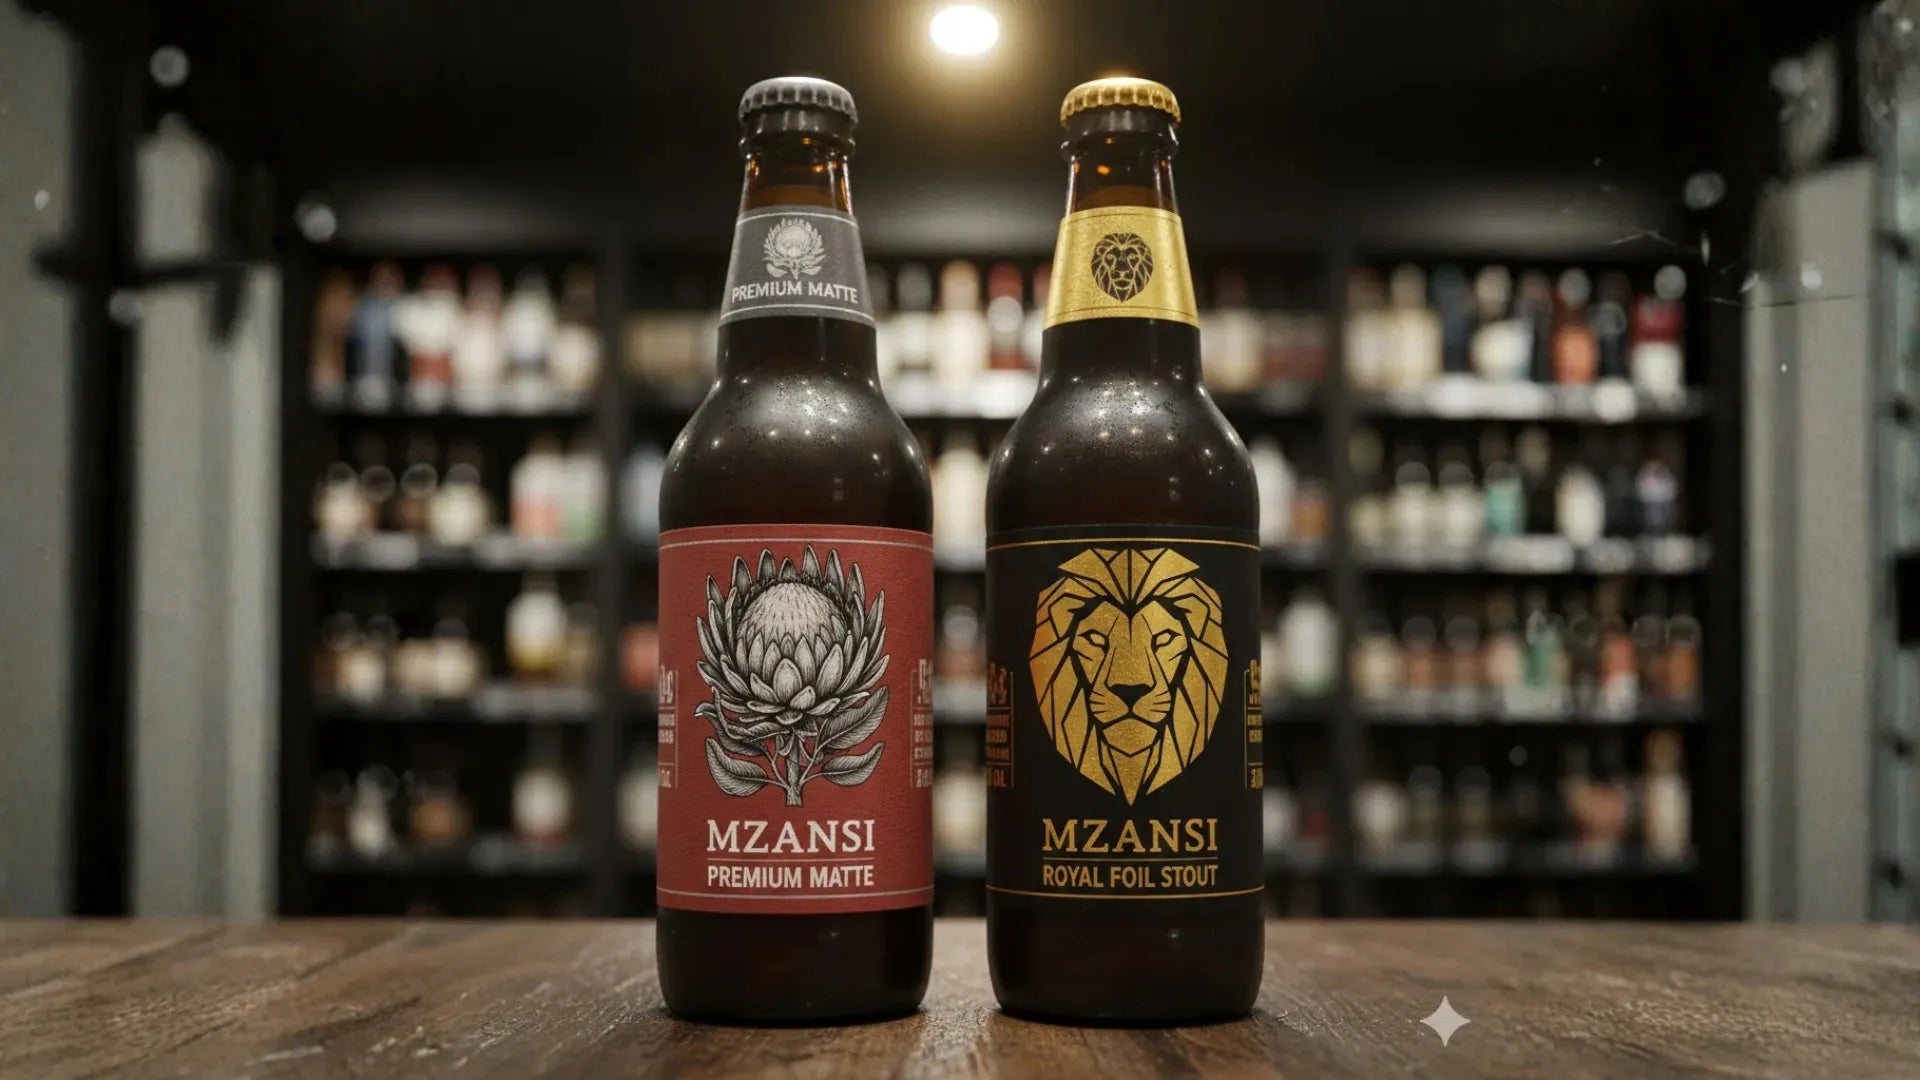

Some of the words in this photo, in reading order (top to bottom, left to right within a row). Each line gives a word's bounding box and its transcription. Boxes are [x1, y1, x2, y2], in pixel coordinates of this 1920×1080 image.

[731, 280, 803, 304] PREMIUM
[808, 281, 859, 304] MATTE
[706, 819, 876, 853] MZANSI
[1042, 818, 1218, 853] MZANSI
[707, 865, 802, 888] PREMIUM
[809, 865, 875, 888] MATTE
[1043, 864, 1104, 888] ROYAL
[1110, 866, 1156, 888] FOIL
[1160, 864, 1219, 888] STOUT
